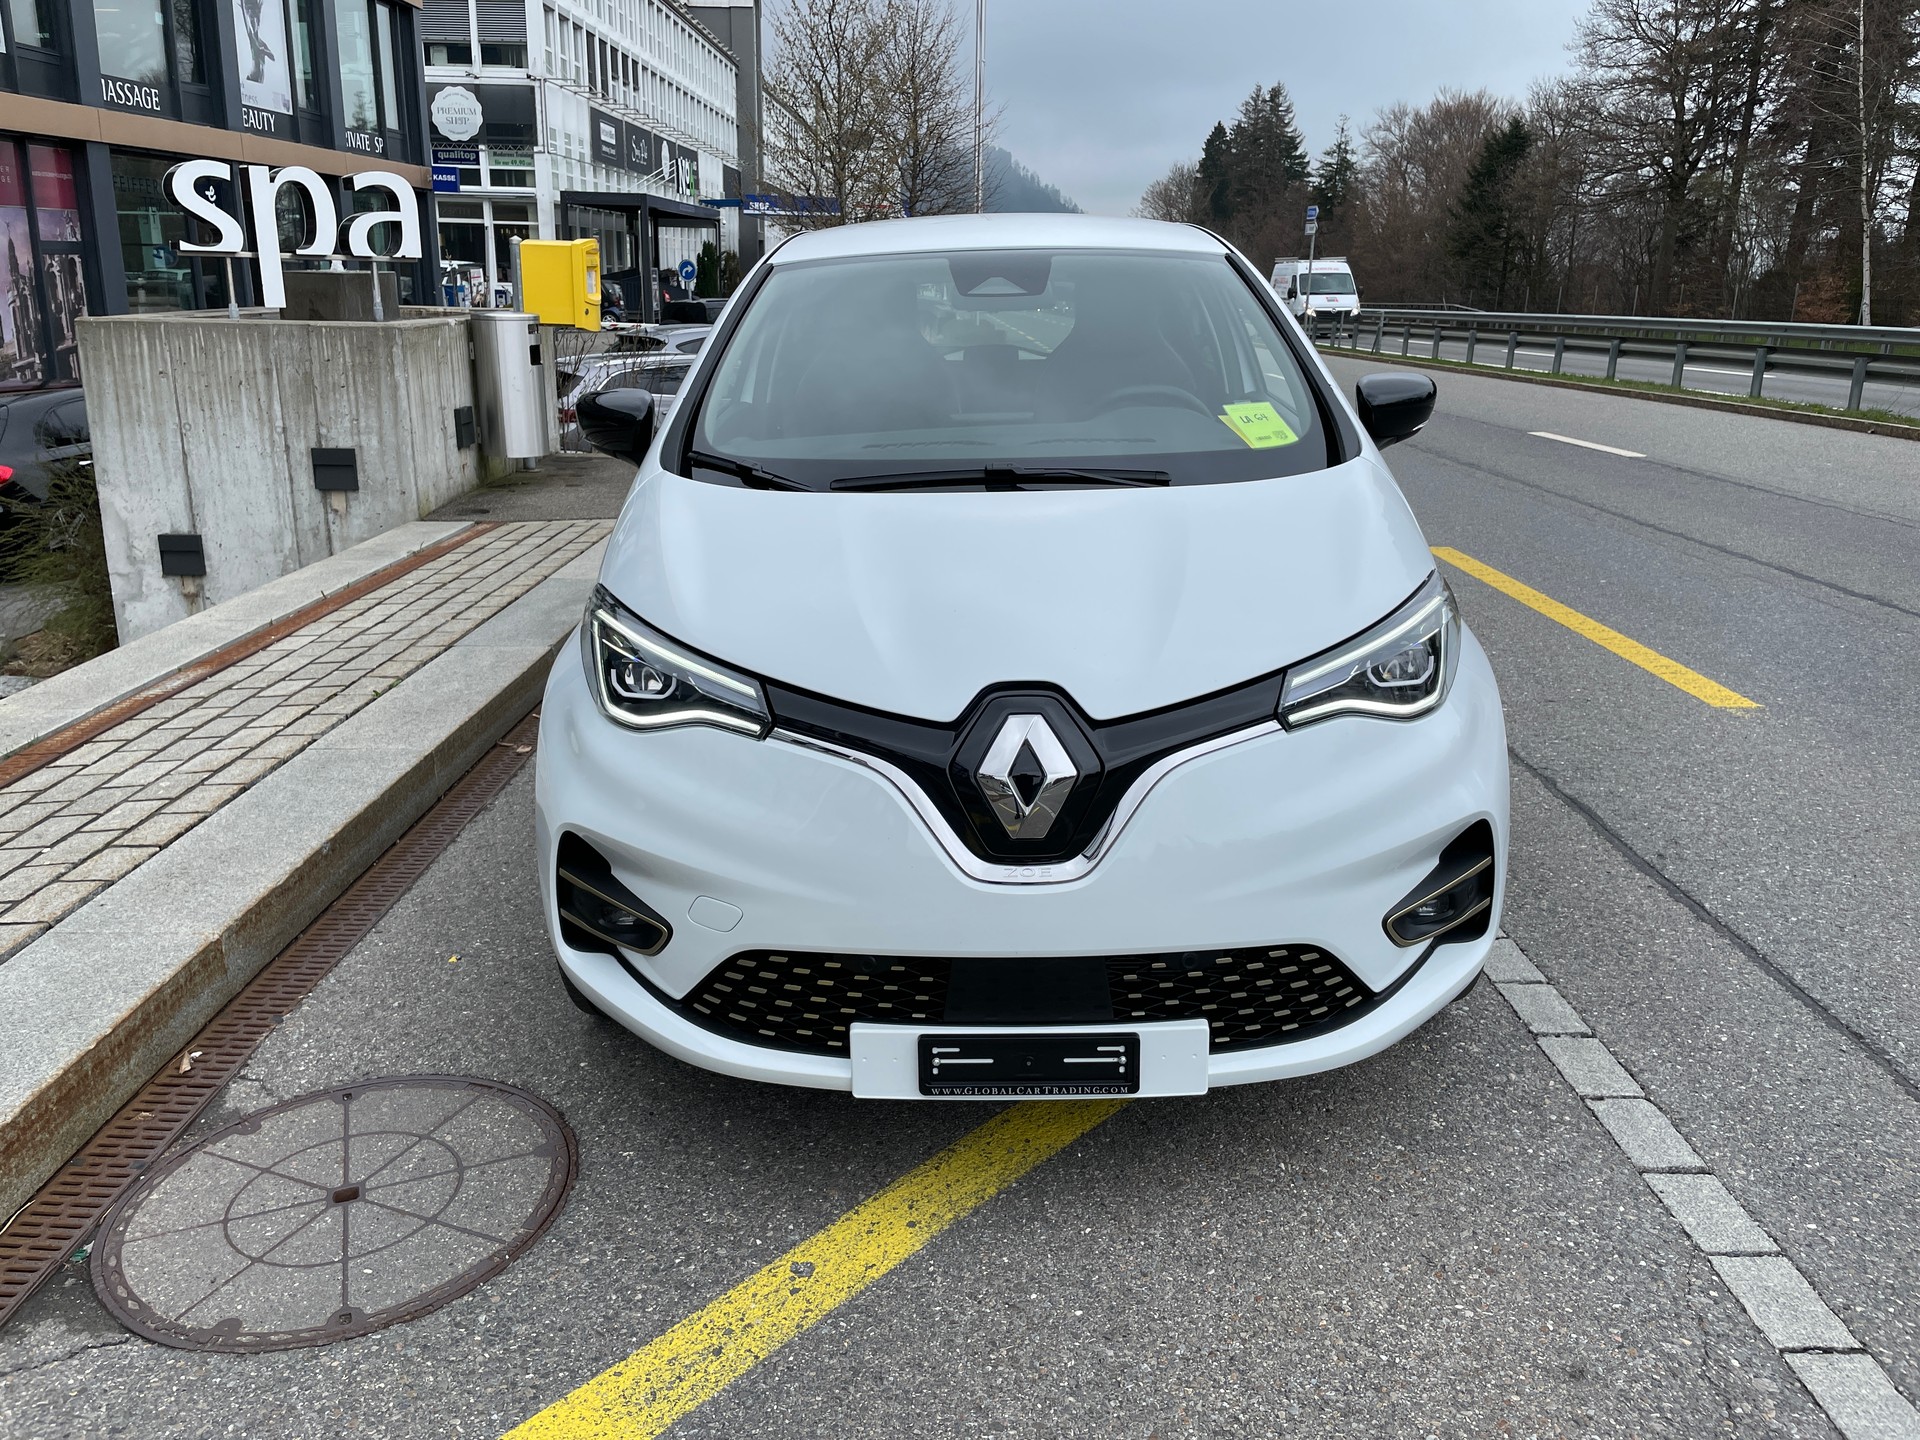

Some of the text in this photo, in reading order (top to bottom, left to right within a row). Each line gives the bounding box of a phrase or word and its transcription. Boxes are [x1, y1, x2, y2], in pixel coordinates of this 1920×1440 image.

[436, 107, 477, 116] PREMIUM
[242, 108, 275, 133] EAUTY
[445, 116, 470, 125] SHOP
[346, 131, 371, 151] IVATE
[438, 151, 477, 160] qualitop
[165, 159, 421, 308] spa
[1003, 868, 1053, 878] ZOE
